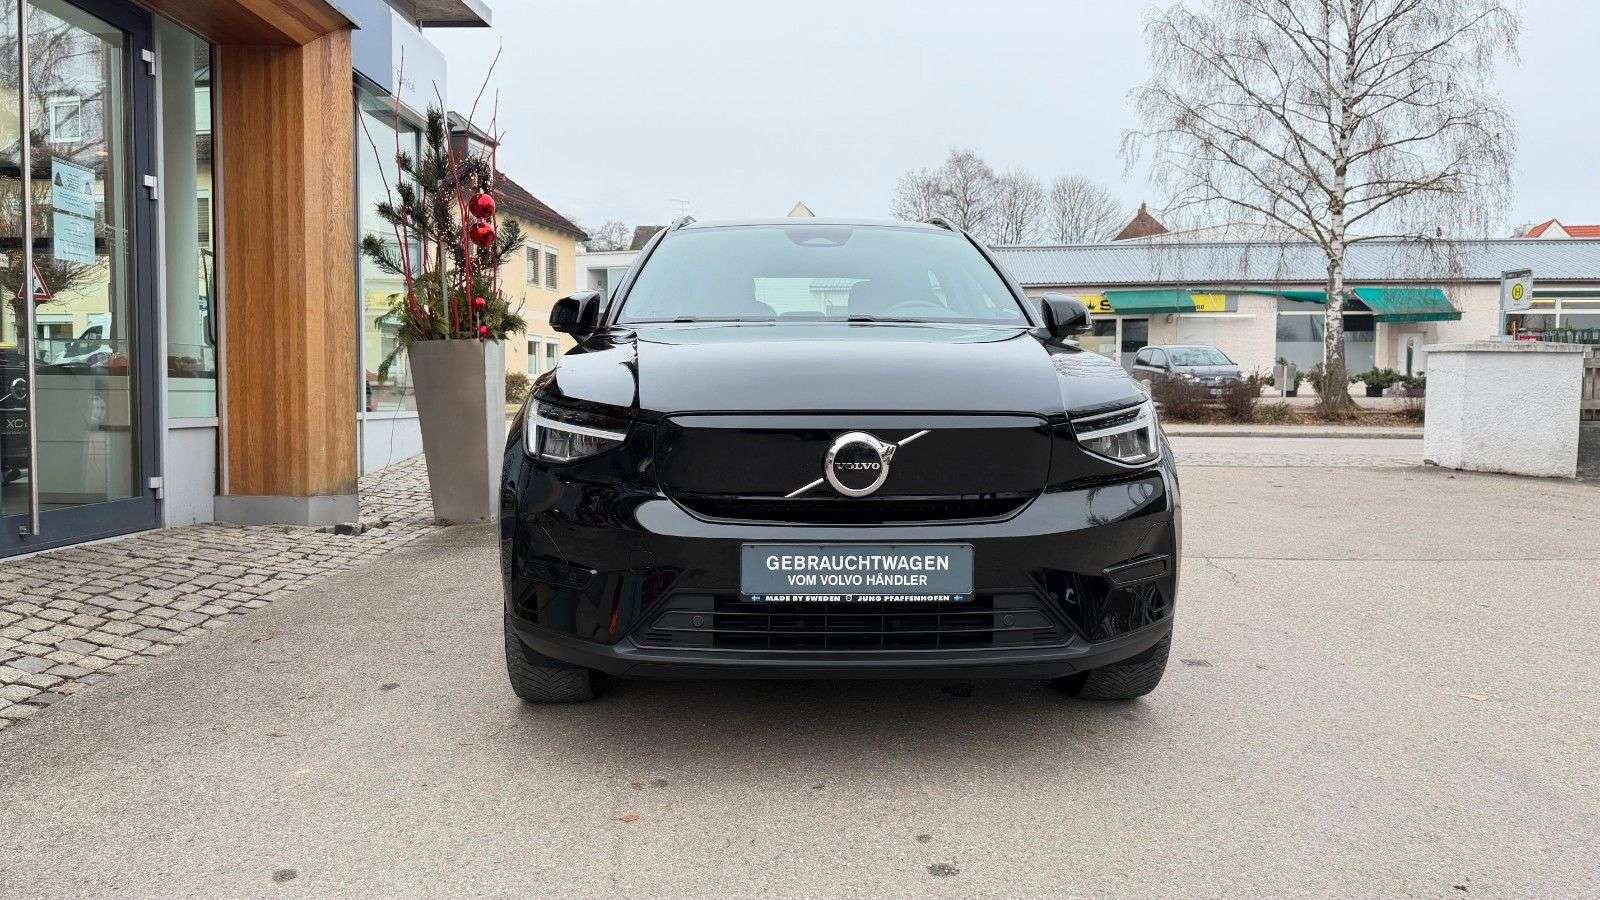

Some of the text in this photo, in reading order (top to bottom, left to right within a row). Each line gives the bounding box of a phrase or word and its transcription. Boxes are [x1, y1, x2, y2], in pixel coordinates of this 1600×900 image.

[834, 462, 881, 470] VOLVO
[765, 555, 950, 571] GEBRAUCHTWAGEN
[787, 572, 928, 586] VOM VOLVO HÄNDLER
